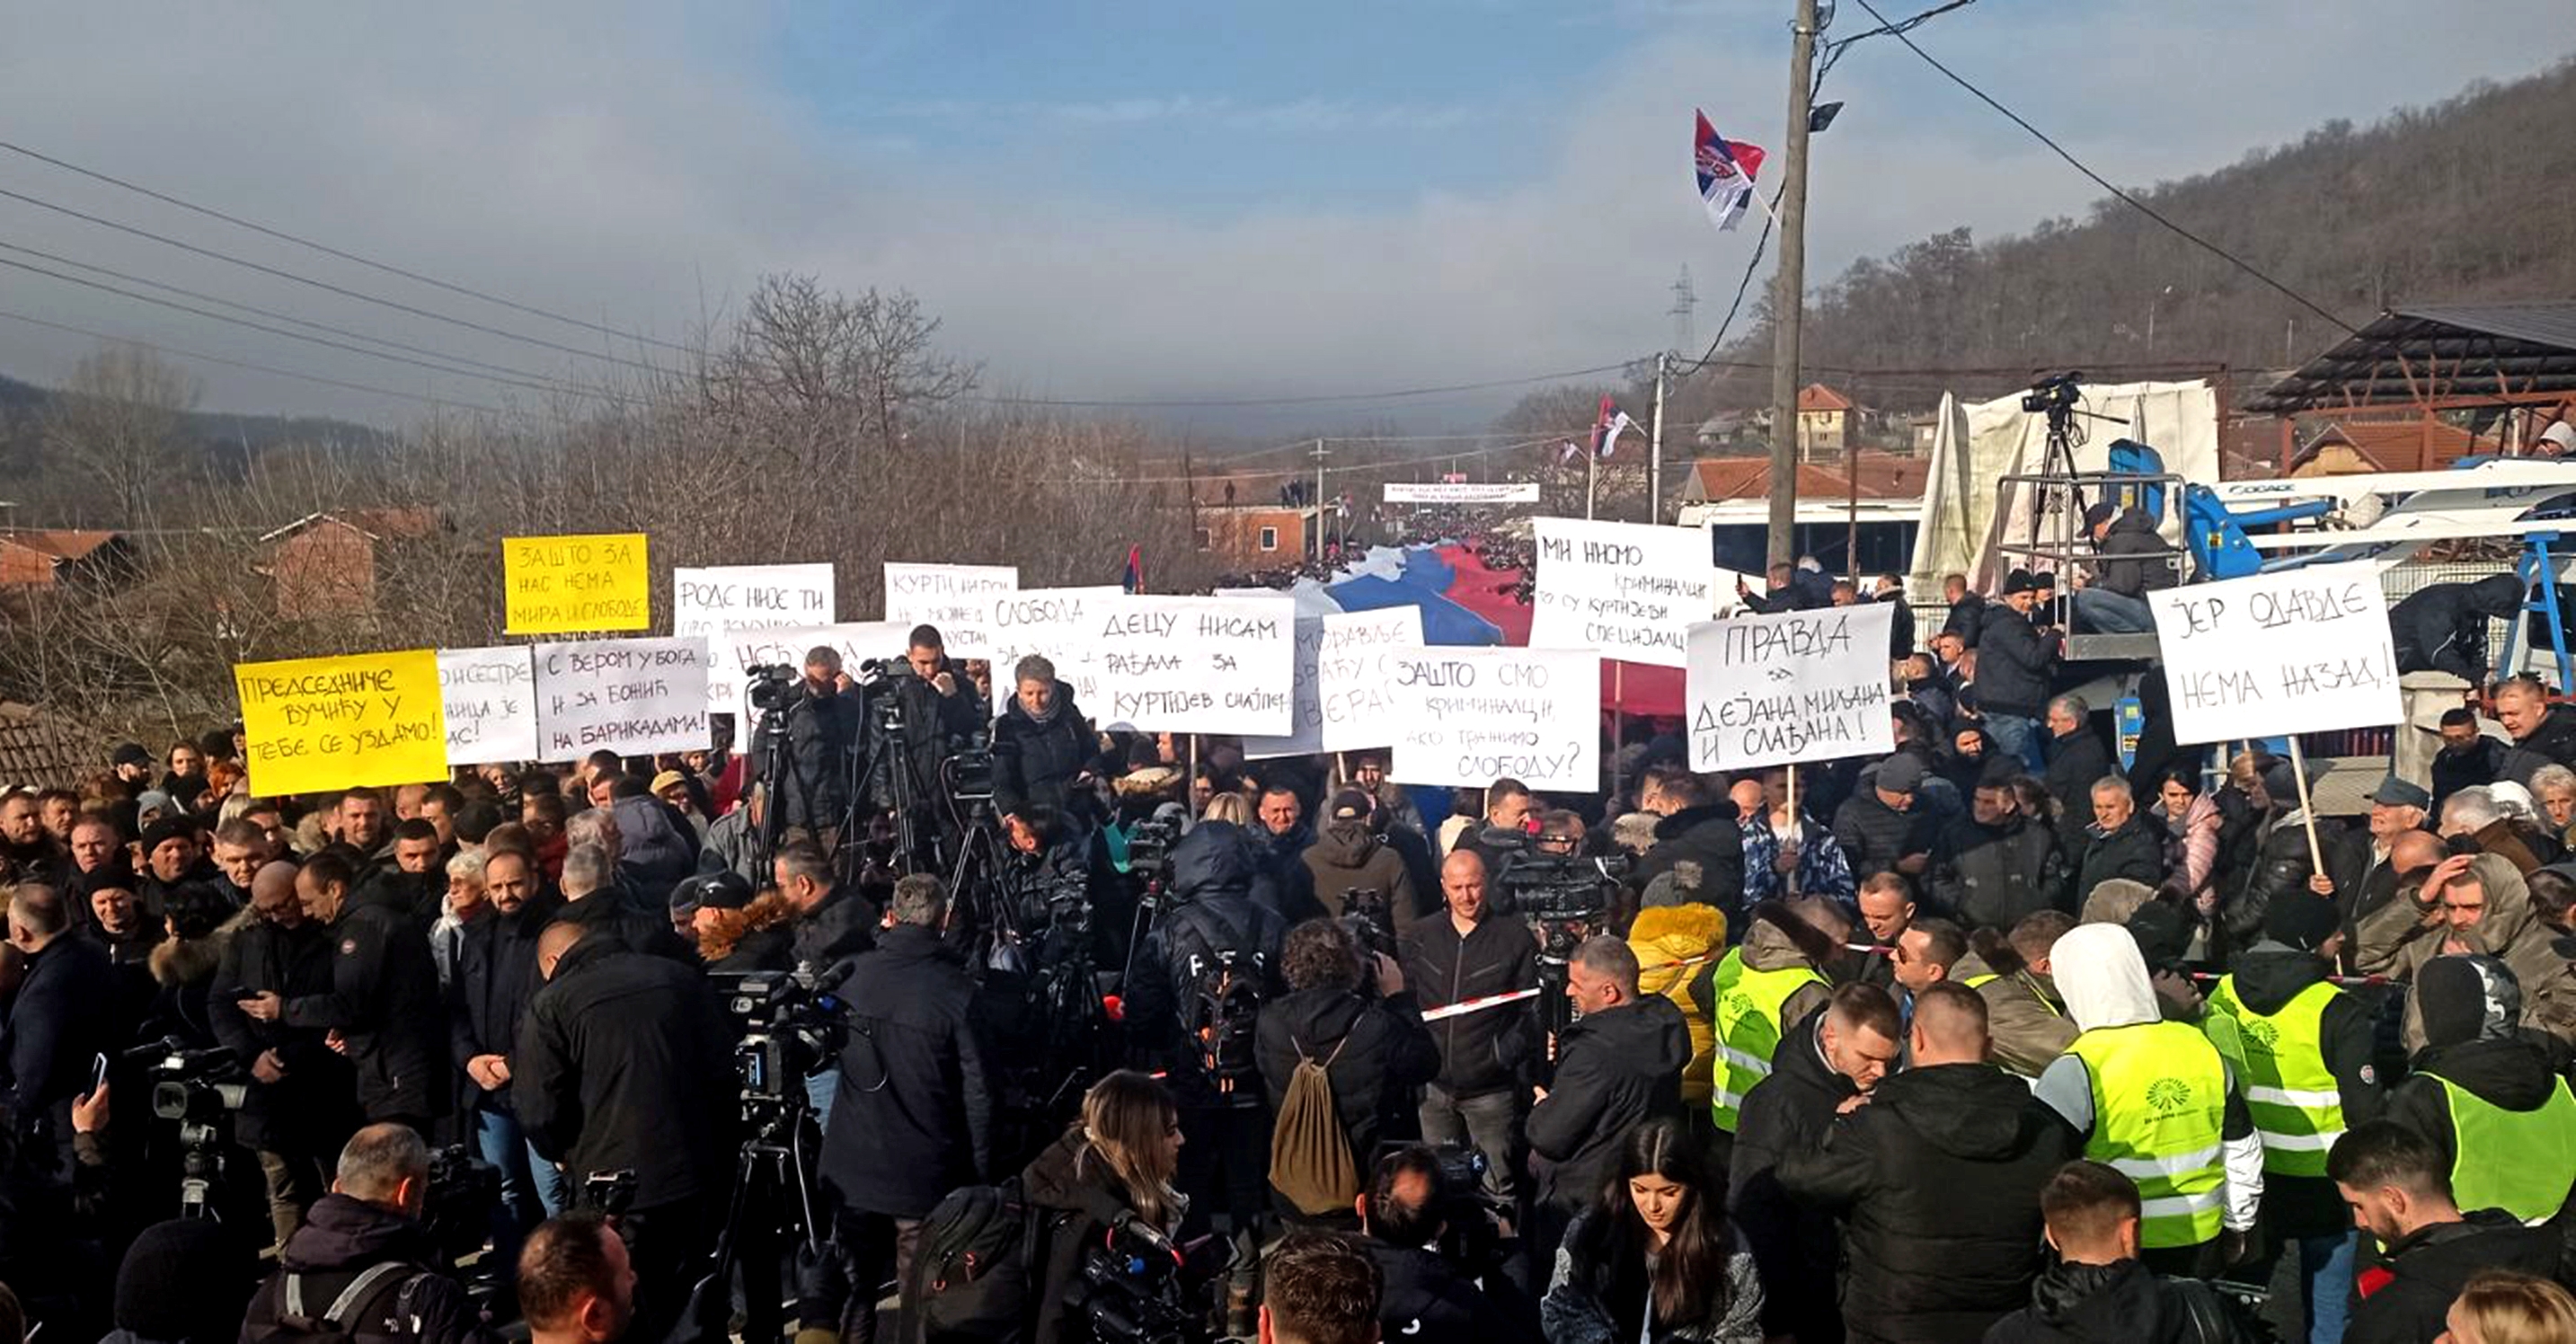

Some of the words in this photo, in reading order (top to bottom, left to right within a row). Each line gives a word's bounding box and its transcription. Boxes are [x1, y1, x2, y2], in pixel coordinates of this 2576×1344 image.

[518, 544, 592, 568] ЗАШТО
[603, 543, 633, 565] ЗА
[1542, 535, 1571, 562] МИ
[1583, 540, 1643, 566] НИСМО
[518, 575, 551, 593] НАС
[564, 570, 615, 590] НЕМА
[513, 605, 562, 624] МИРА
[798, 589, 824, 610] ТИ
[996, 598, 1084, 628] СЛОБОДА
[2171, 597, 2226, 639] ЈЕР
[2250, 582, 2368, 629] ОДАВДЕ
[1102, 612, 1178, 638] ДЕЦУ
[1198, 613, 1278, 640] НИСАМ
[1585, 622, 1686, 653] СПЕЦИЈАЛЦ
[1725, 615, 1852, 666] ПРАВДА
[547, 654, 560, 675] С
[569, 650, 633, 677] ВЕРОМ
[639, 651, 652, 671] У
[655, 649, 695, 667] БОГА
[1104, 650, 1182, 676] РАЂАЛА
[1212, 653, 1237, 671] ЗА
[1396, 661, 1475, 688] ЗАШТО
[1499, 663, 1548, 688] СМО
[241, 669, 395, 703] ПРЕДСЕДНИЧЕ
[575, 691, 598, 707] ЗА
[607, 679, 668, 703] БОЖИЋ
[2181, 670, 2262, 710] НЕМА
[279, 698, 368, 726] ВУЧИЋУ
[383, 694, 401, 720] У
[1114, 690, 1214, 719] КУРТИЈЕВ
[252, 738, 310, 762] ТЕБЕ
[319, 733, 343, 754] СЕ
[350, 712, 438, 755] УЗДАМО!
[553, 730, 573, 749] НА
[580, 710, 705, 745] БАРИКАДАМА!
[1457, 741, 1580, 779] СЛОБОДУ?
[1702, 734, 1720, 765] И
